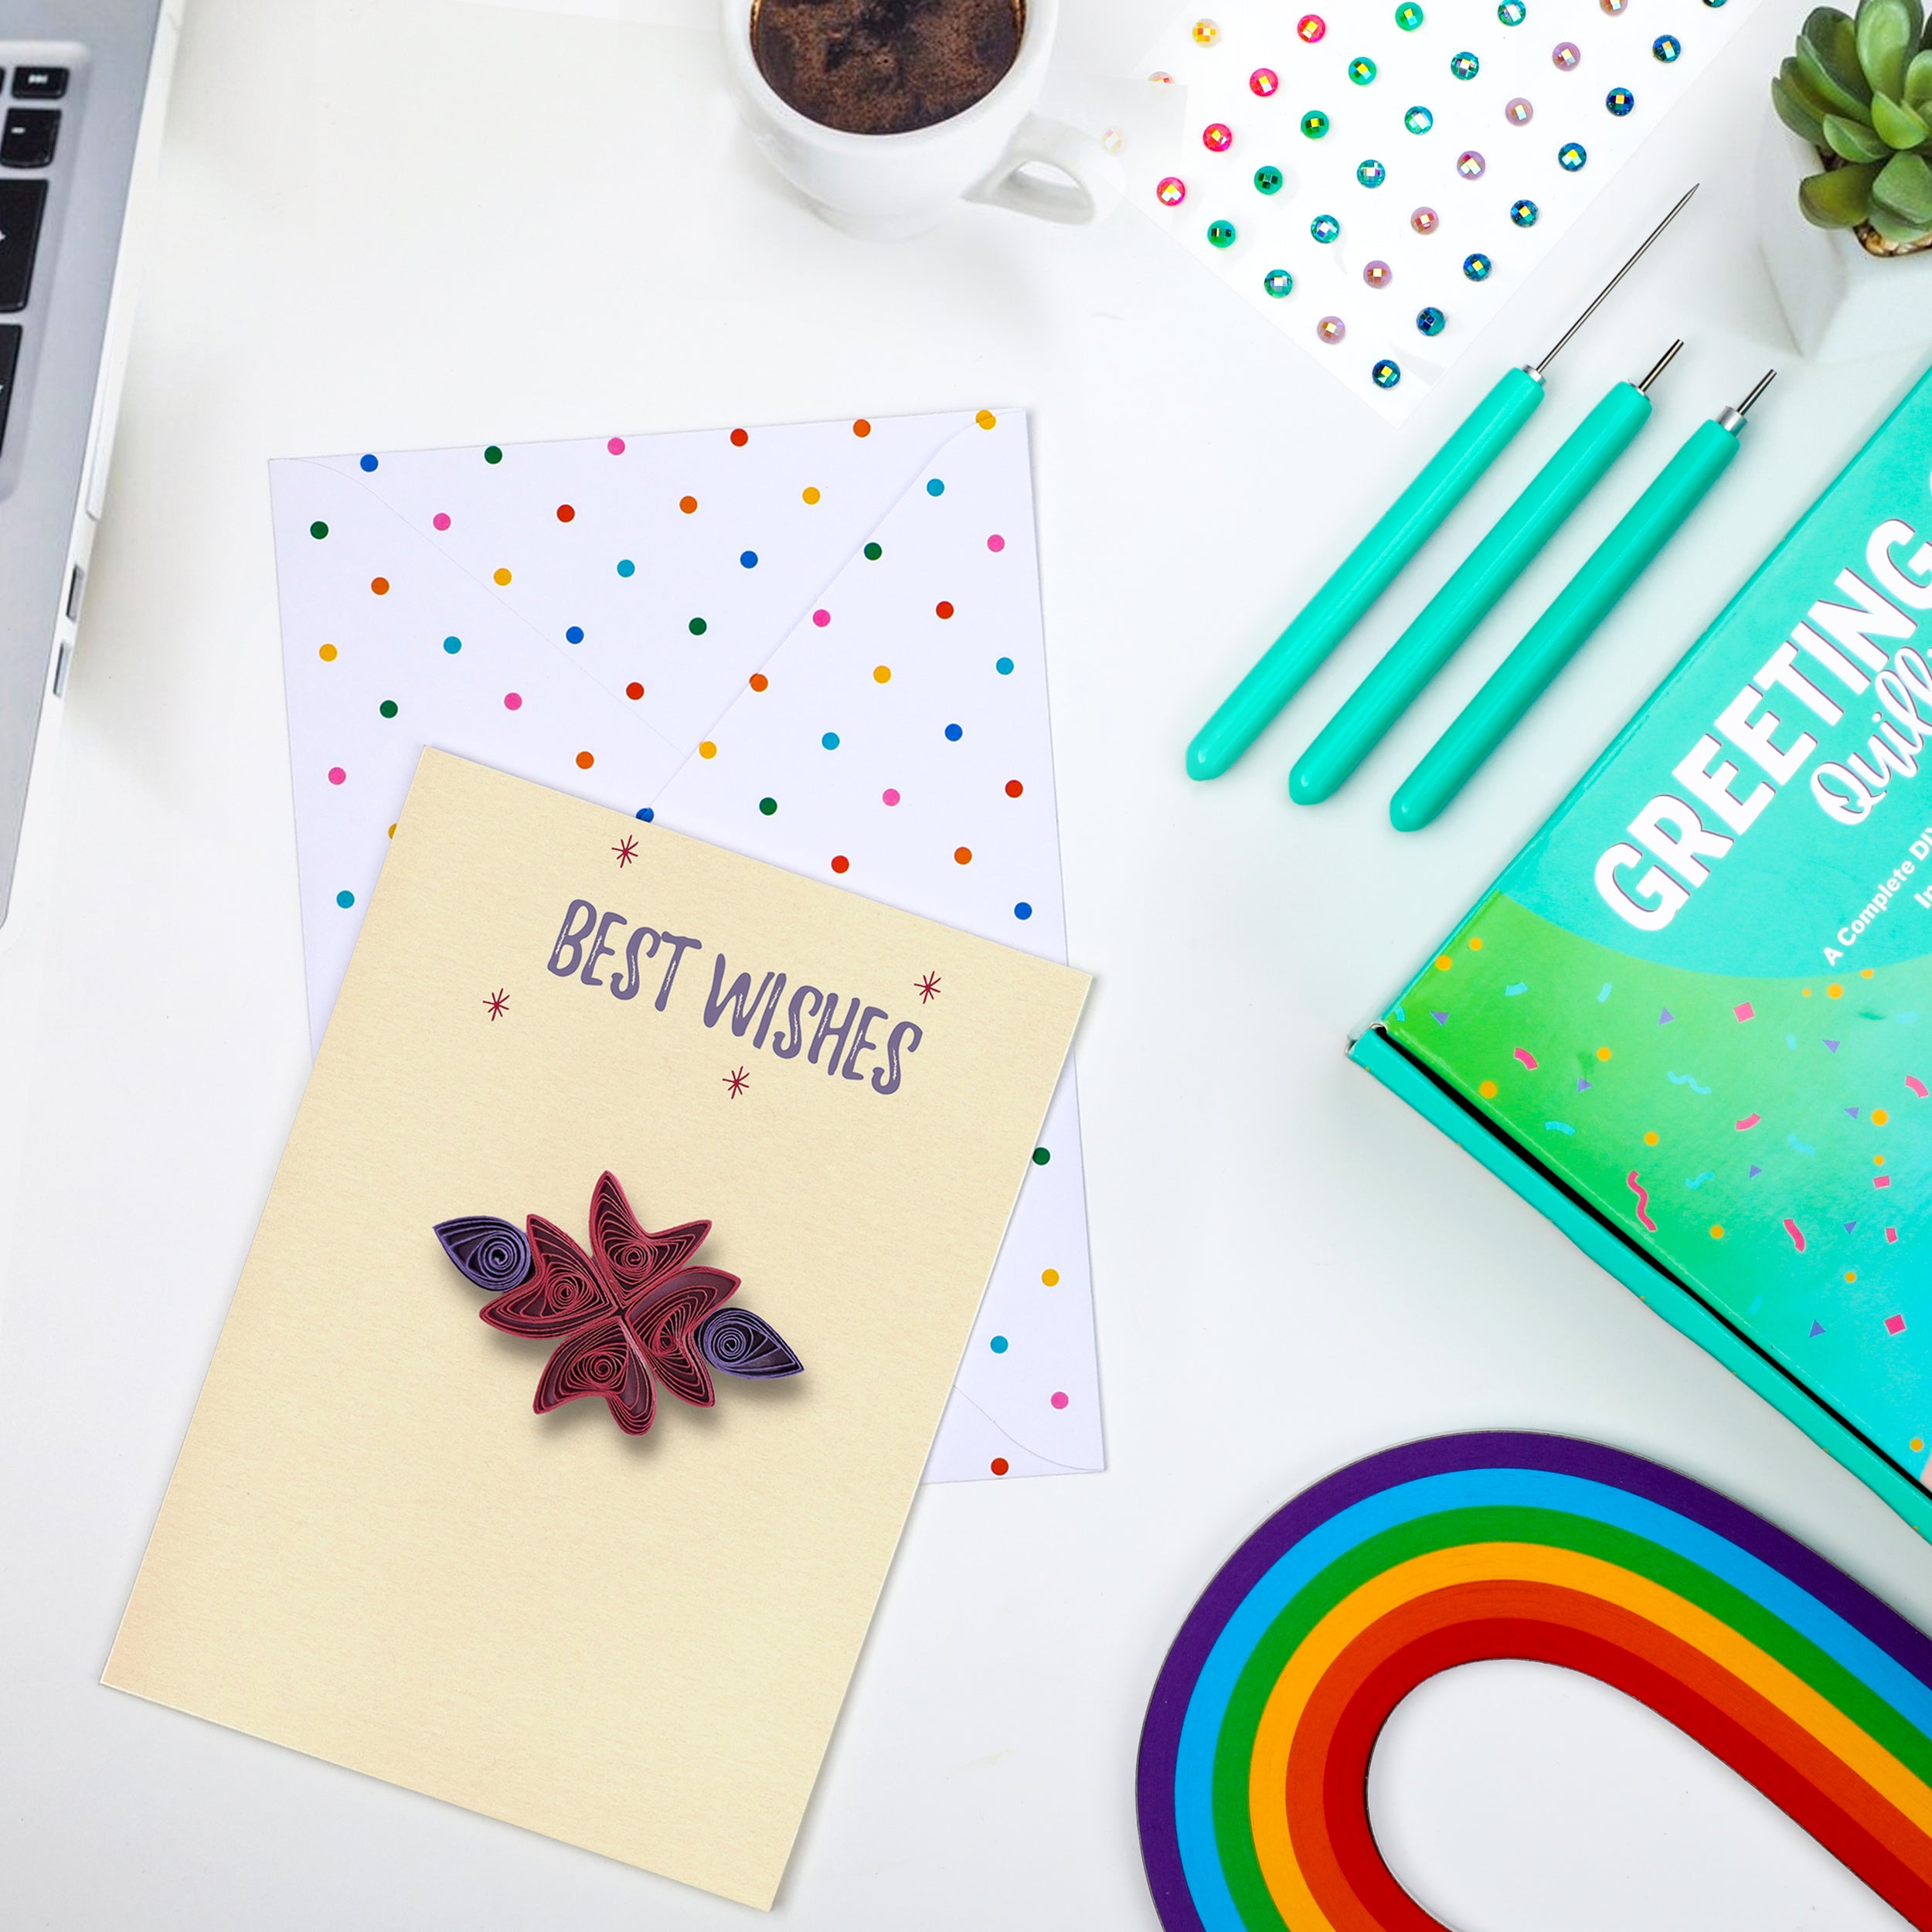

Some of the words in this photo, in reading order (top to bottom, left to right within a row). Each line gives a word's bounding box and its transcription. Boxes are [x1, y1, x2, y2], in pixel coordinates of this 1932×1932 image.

[1594, 519, 1932, 931] GREETING
[546, 899, 702, 1012] BEST
[702, 953, 923, 1096] WISHES
[1823, 946, 1844, 967] A
[1837, 860, 1916, 947] Complete
